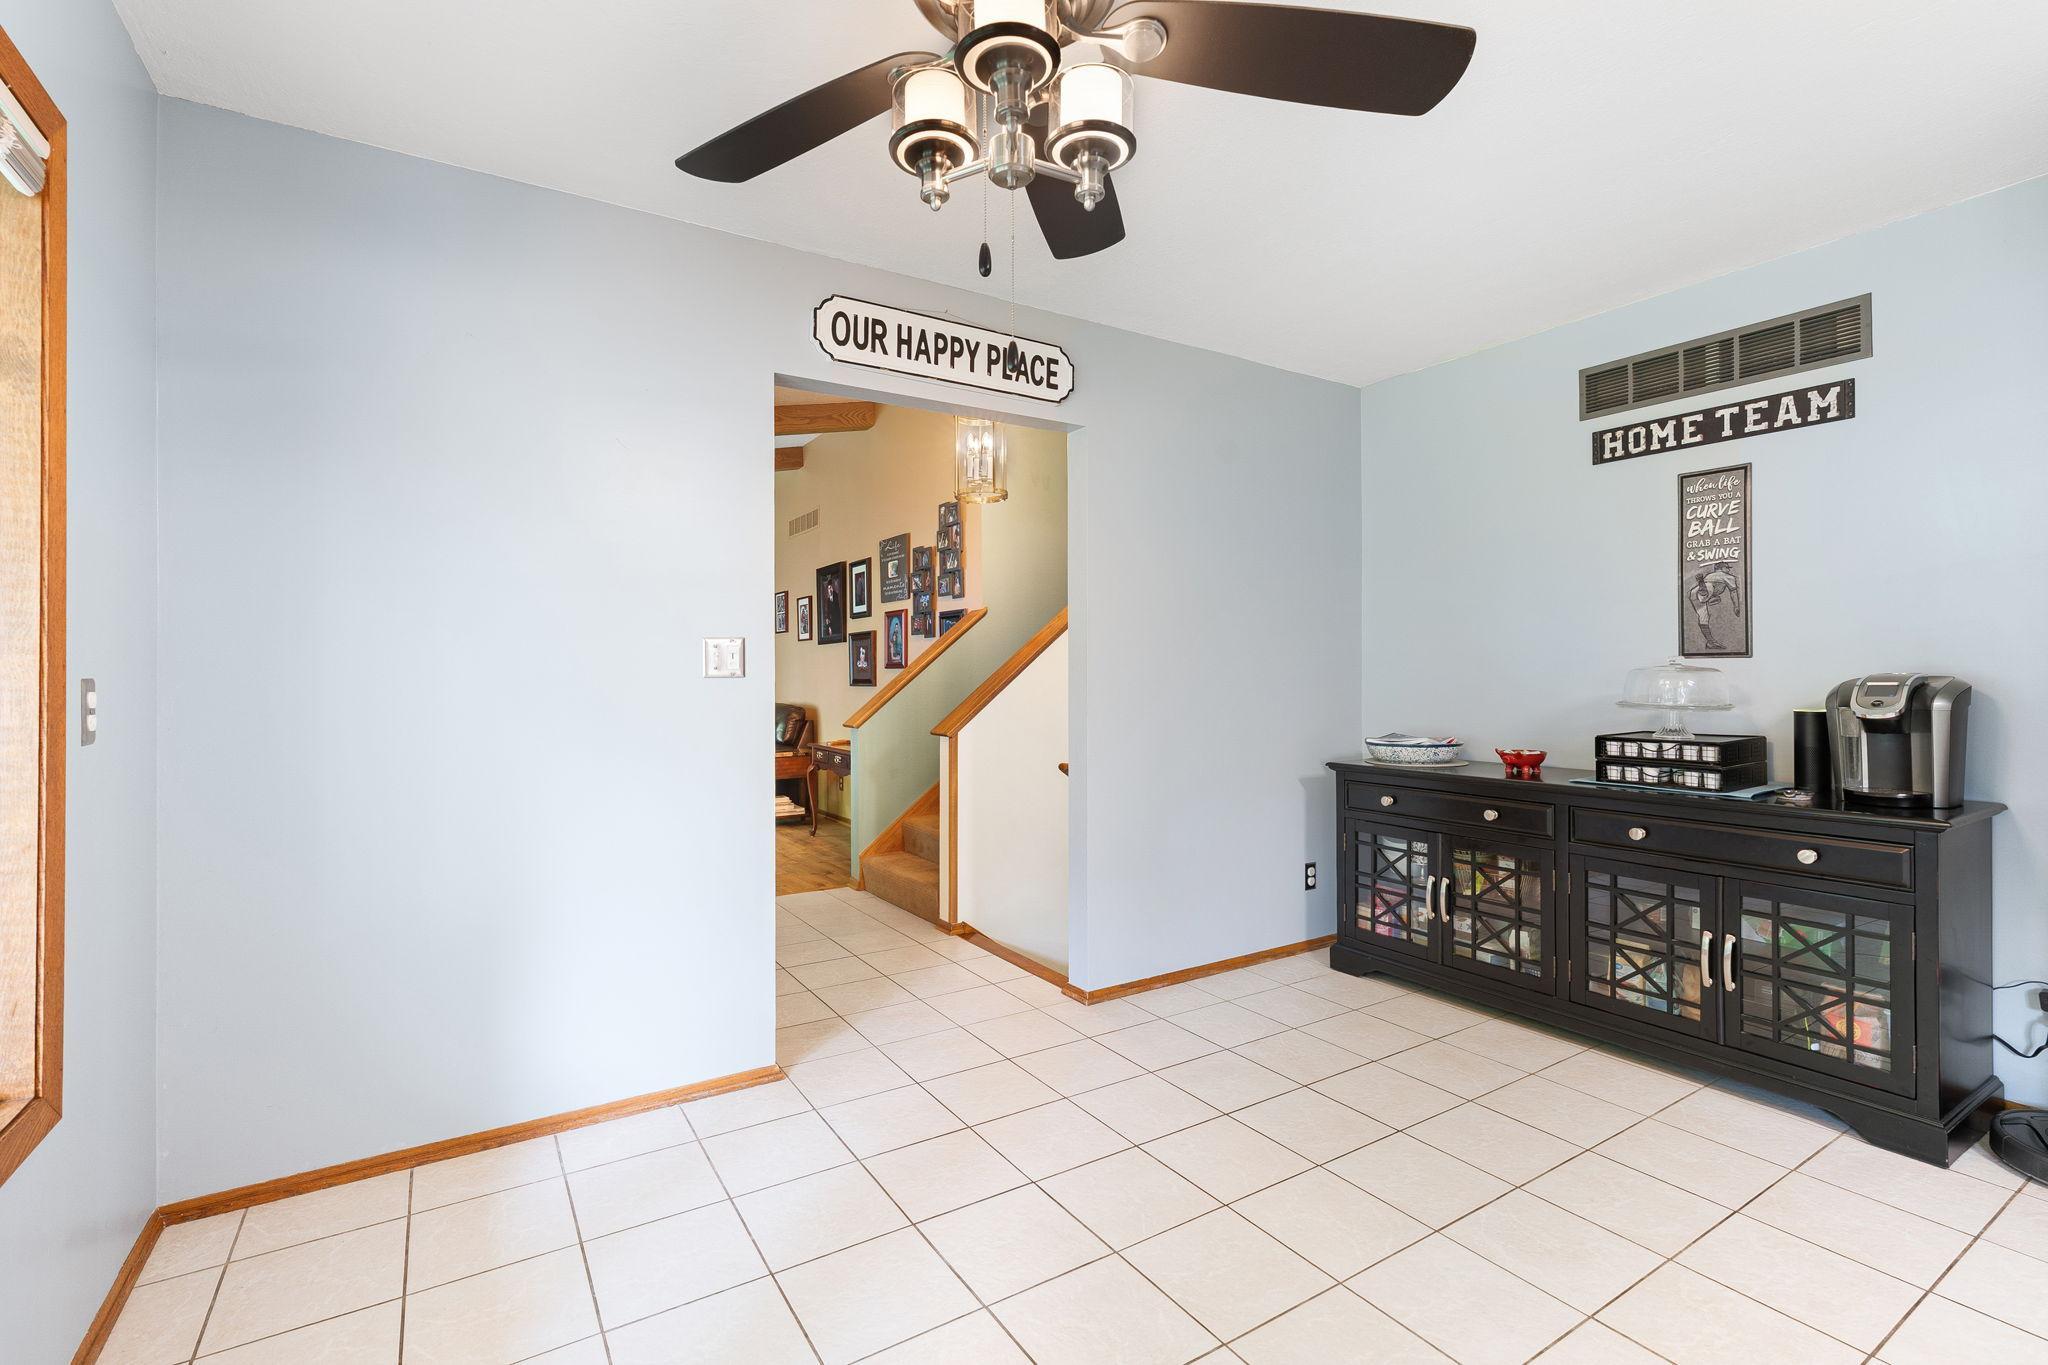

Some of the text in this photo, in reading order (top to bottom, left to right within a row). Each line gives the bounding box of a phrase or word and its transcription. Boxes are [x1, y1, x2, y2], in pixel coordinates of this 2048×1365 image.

[832, 311, 1059, 390] OUR HAPPY PLACE
[1602, 386, 1841, 459] HOME TEAM
[1687, 475, 1741, 493] when life
[1686, 495, 1716, 504] THROWS
[1718, 492, 1733, 500] YOU
[1686, 500, 1741, 520] CURVE
[1688, 518, 1741, 537] BALL
[1686, 540, 1710, 549] GRAB
[1724, 536, 1741, 545] BAT
